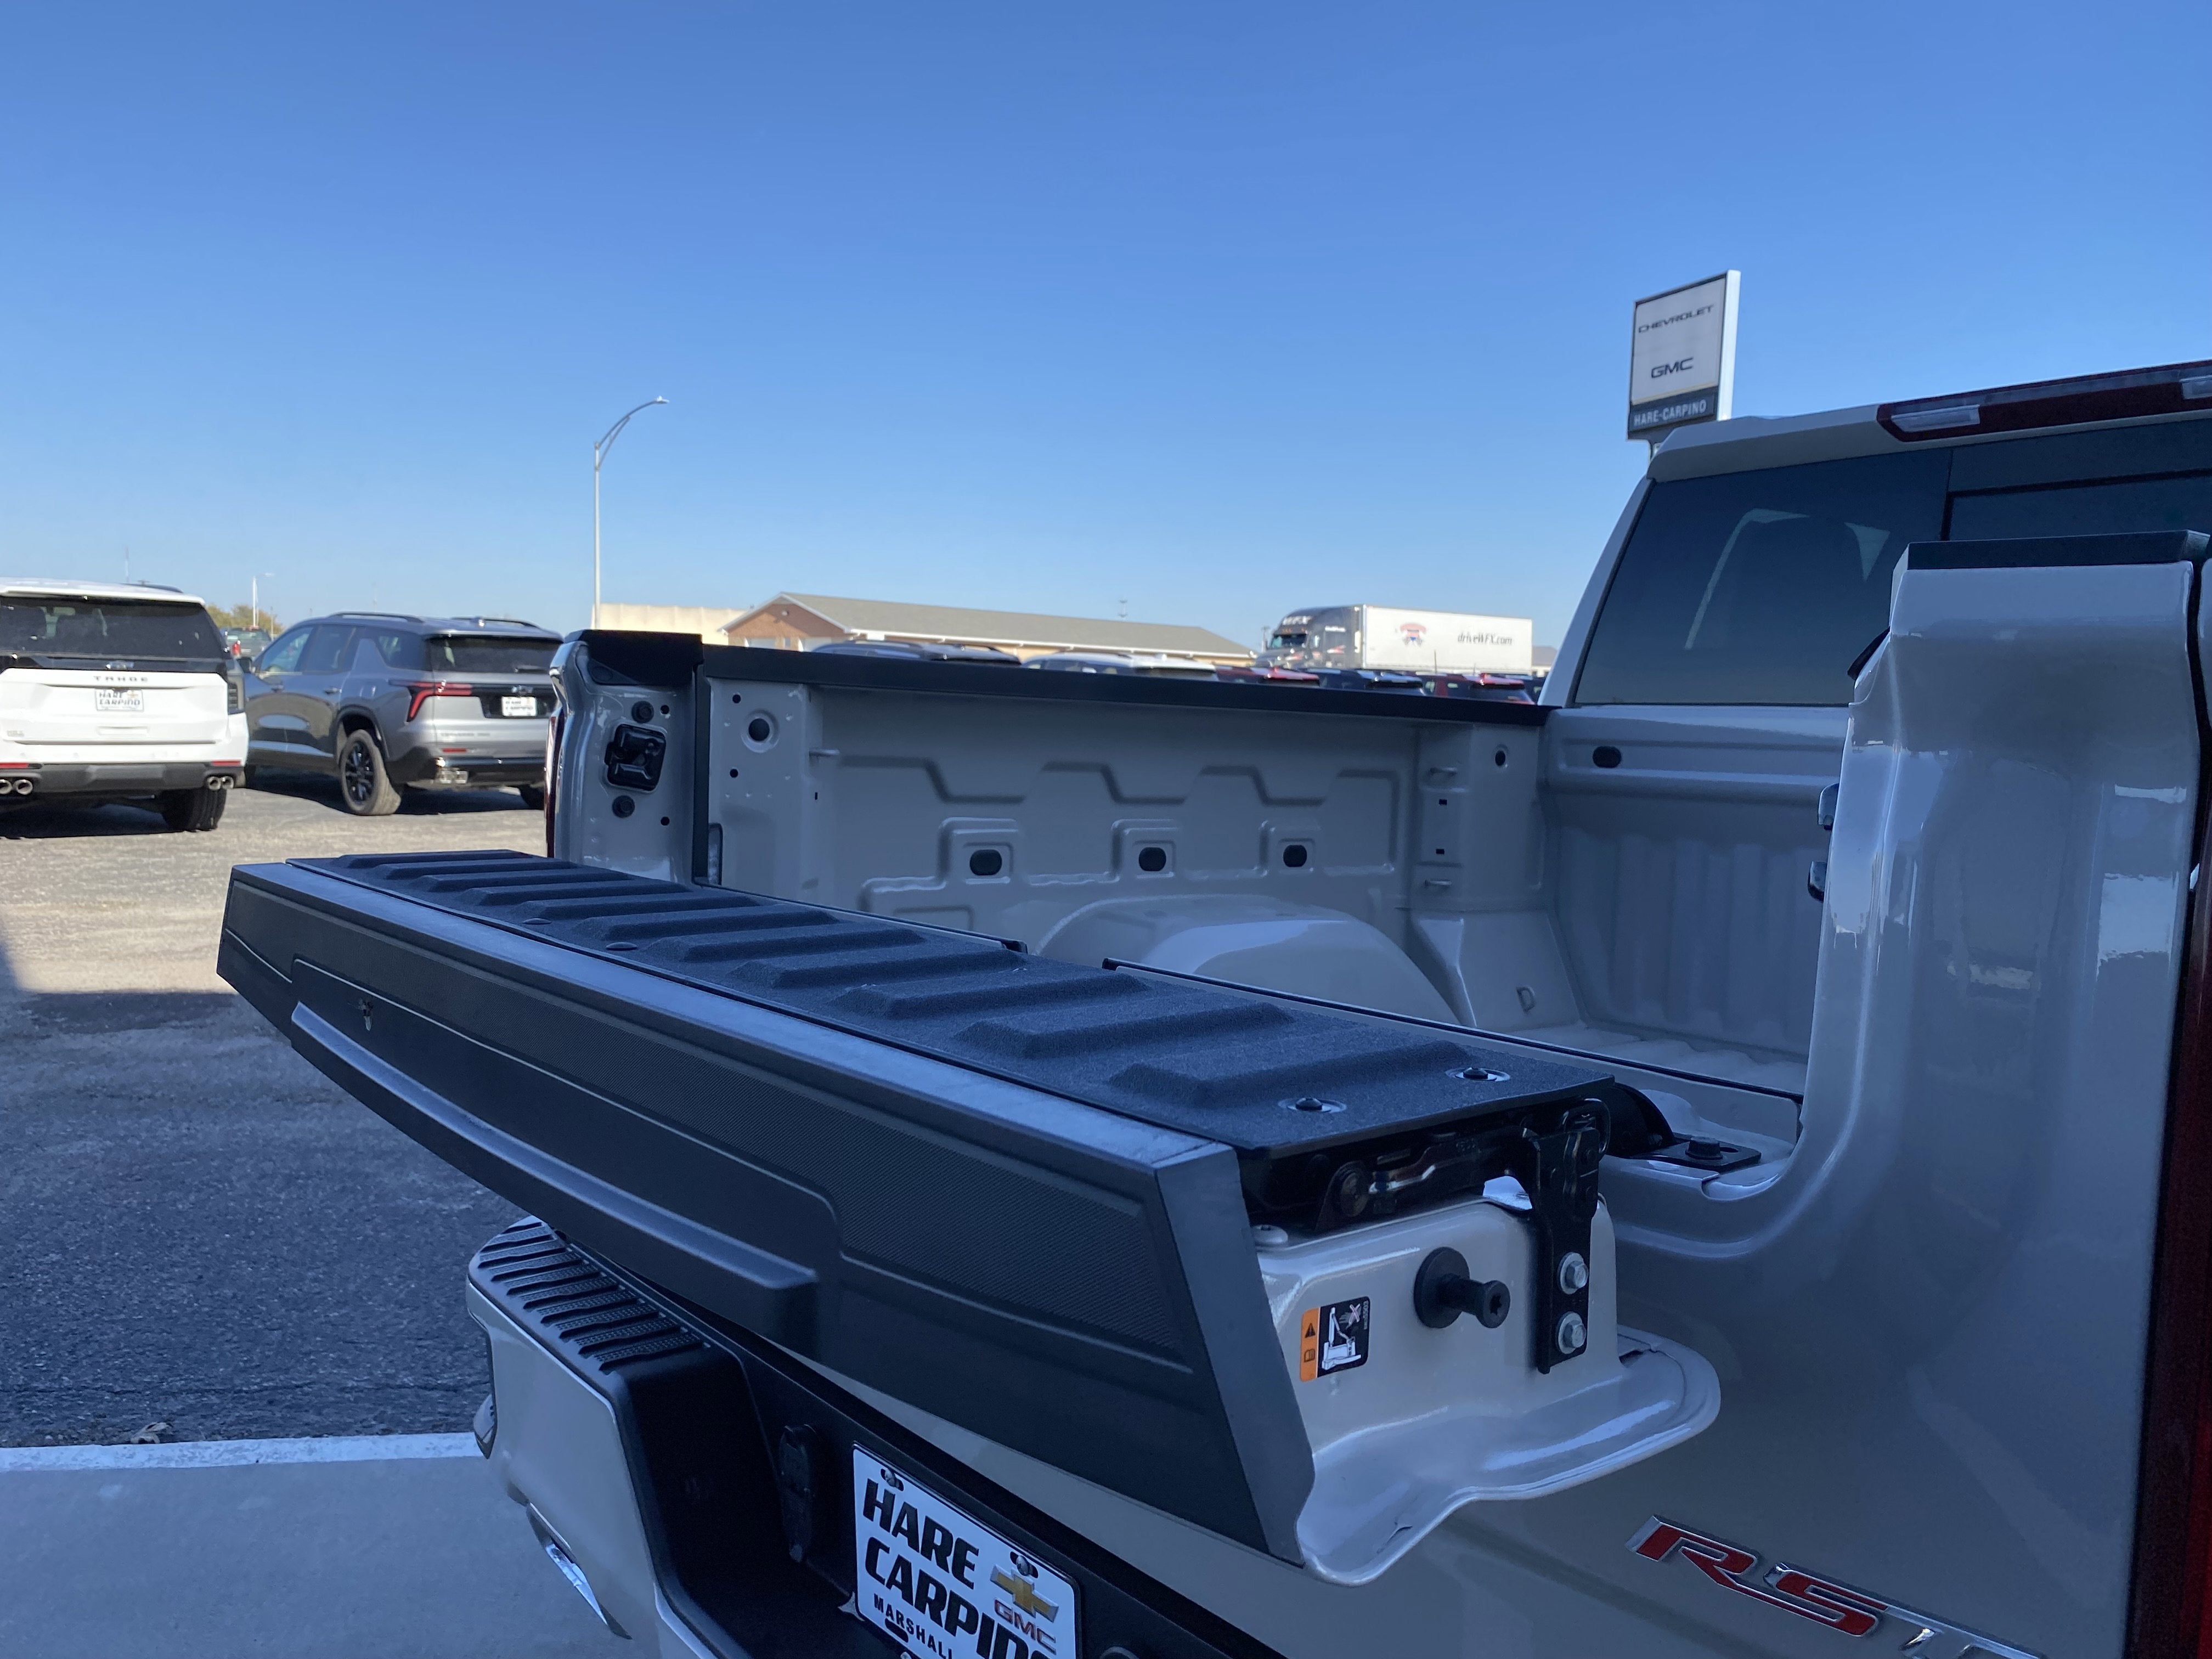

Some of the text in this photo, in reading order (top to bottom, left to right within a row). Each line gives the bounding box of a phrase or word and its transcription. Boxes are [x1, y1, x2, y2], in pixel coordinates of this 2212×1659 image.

[1639, 304, 1713, 333] CHEVROLET
[1651, 357, 1694, 379] GMC
[1634, 399, 1706, 425] HARE-CARPINO
[863, 1478, 979, 1590] HARE
[865, 1536, 1051, 1659] CARPIN
[994, 1596, 1057, 1655] GMC
